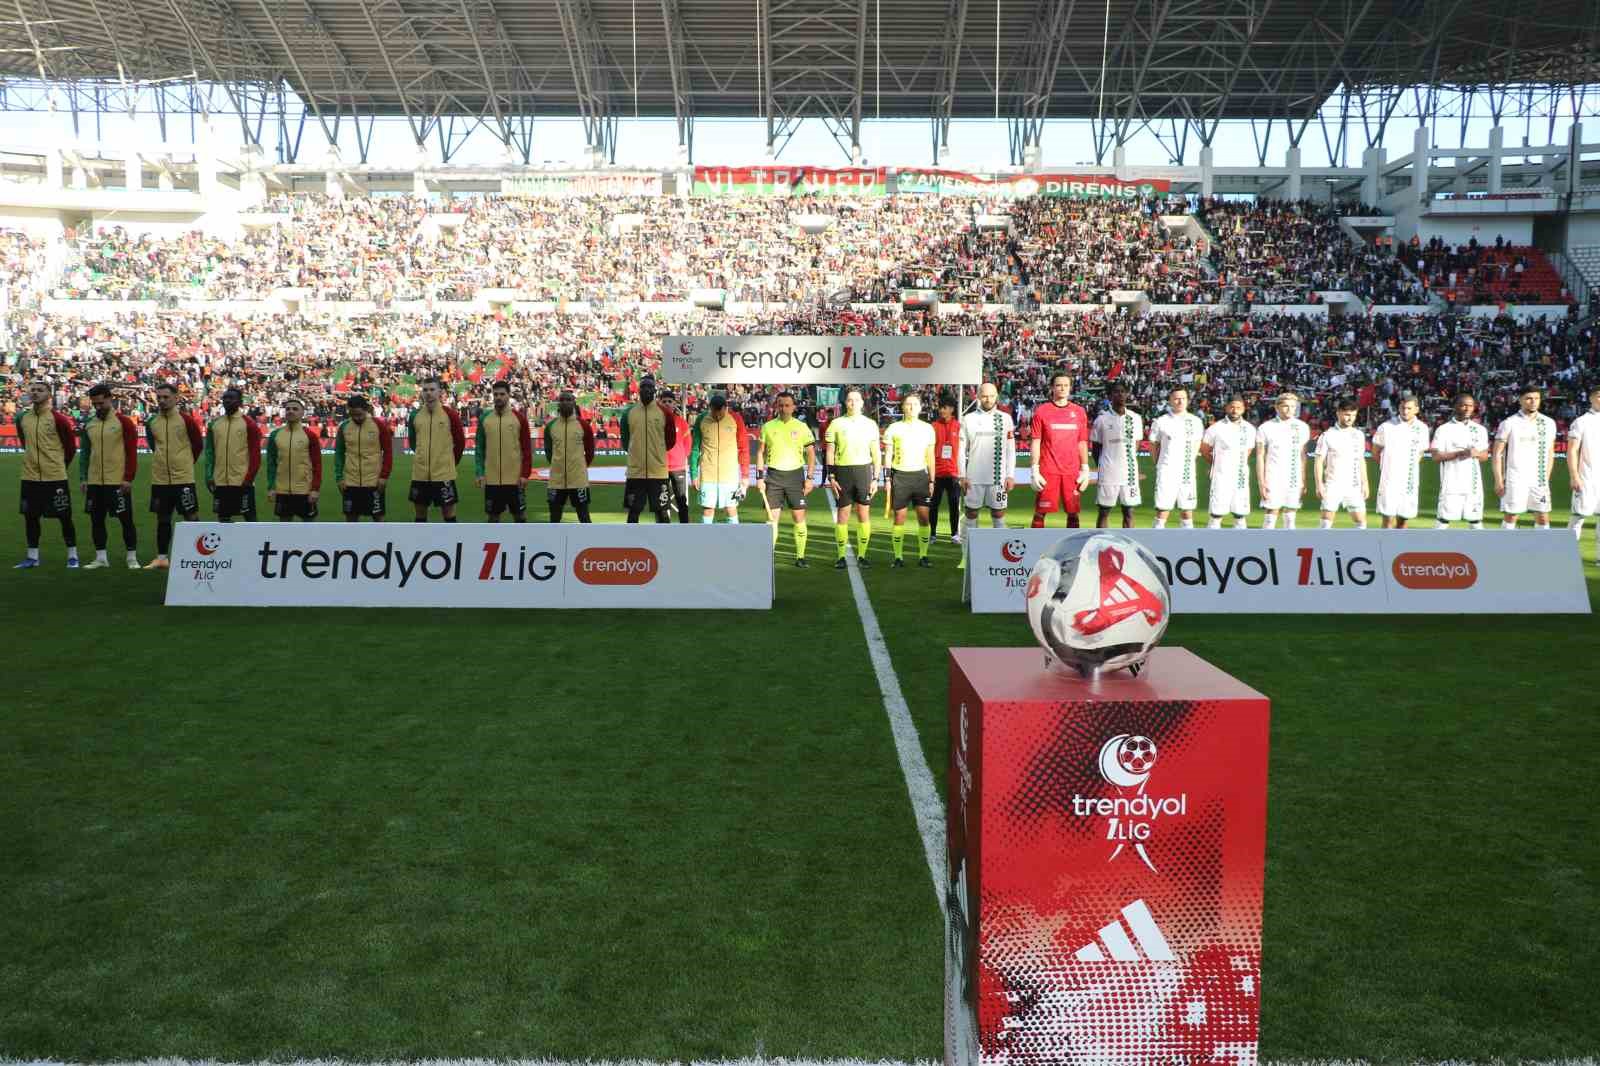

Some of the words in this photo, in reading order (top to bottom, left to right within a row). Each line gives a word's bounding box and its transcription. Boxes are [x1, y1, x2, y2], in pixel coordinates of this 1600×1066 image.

[716, 346, 831, 373] trendyol
[996, 491, 1007, 502] 86
[180, 558, 232, 571] trendyol
[258, 541, 463, 588] trendyol
[582, 558, 650, 576] trendyol
[989, 566, 1033, 577] trendy
[1155, 547, 1279, 594] ndyol
[1400, 562, 1471, 580] trendyol
[1072, 793, 1187, 820] trendyol
